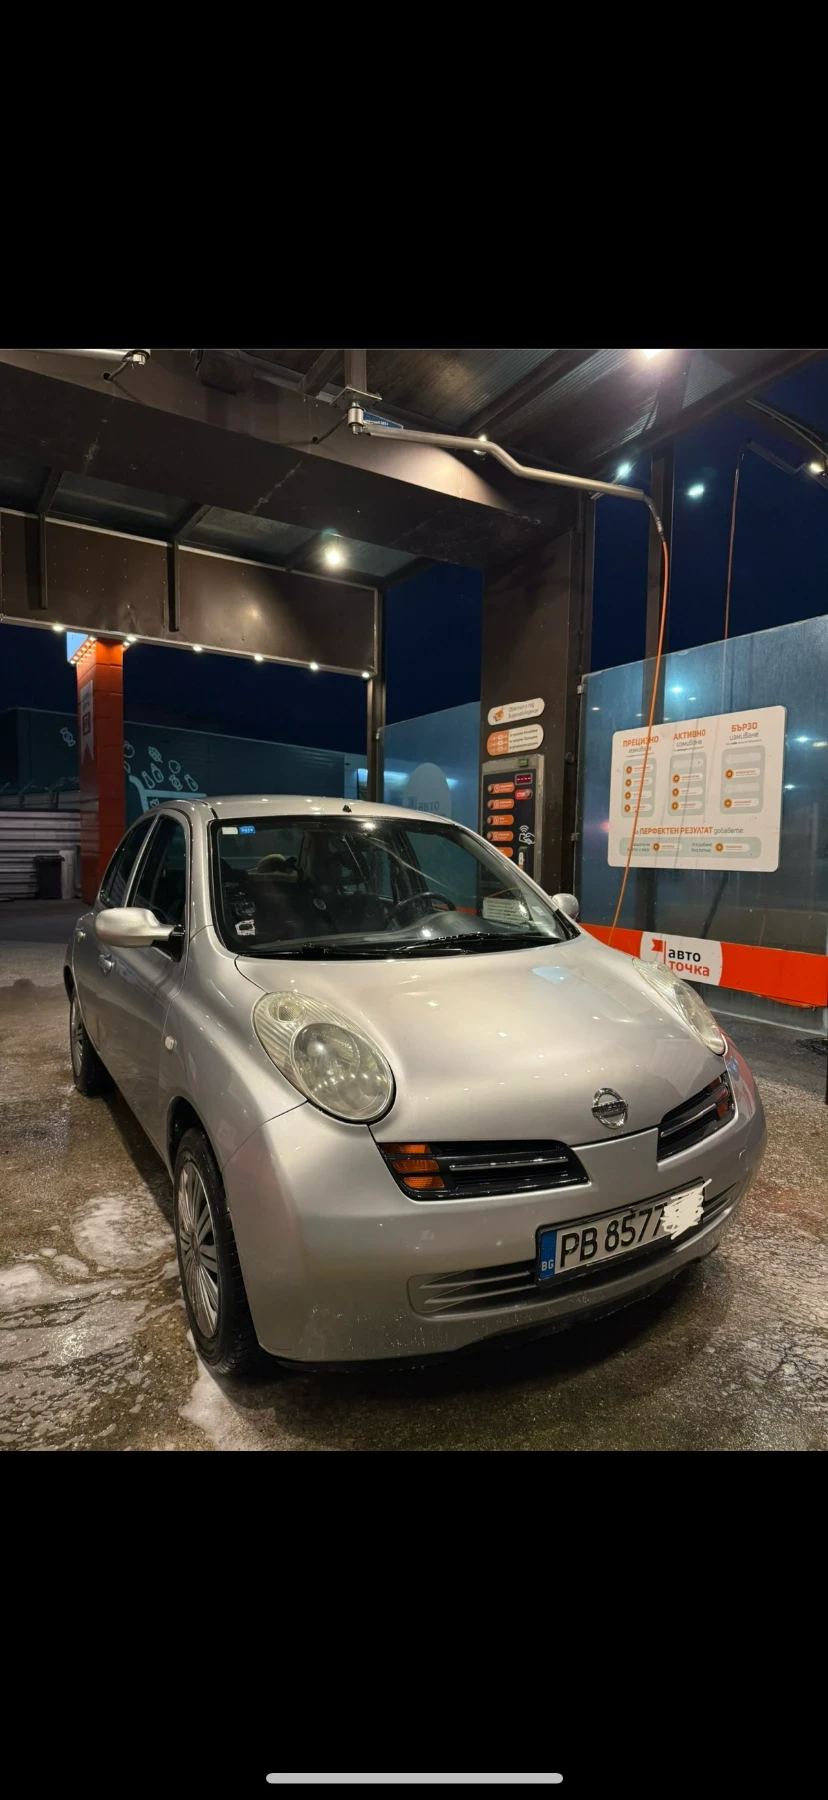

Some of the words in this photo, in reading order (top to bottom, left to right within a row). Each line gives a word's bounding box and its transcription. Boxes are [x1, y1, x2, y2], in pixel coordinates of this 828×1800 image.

[731, 722, 758, 733] БЪРЗО
[673, 729, 706, 741] АКТИВНО
[729, 731, 759, 741] измиване
[639, 827, 680, 835] ПЕРФЕКТЕН
[680, 826, 713, 835] РЕЗУЛТАТ
[668, 948, 702, 962] авто
[668, 960, 711, 977] точка
[560, 1227, 599, 1268] PB
[604, 1202, 668, 1253] 8577
[541, 1259, 555, 1272] BG
